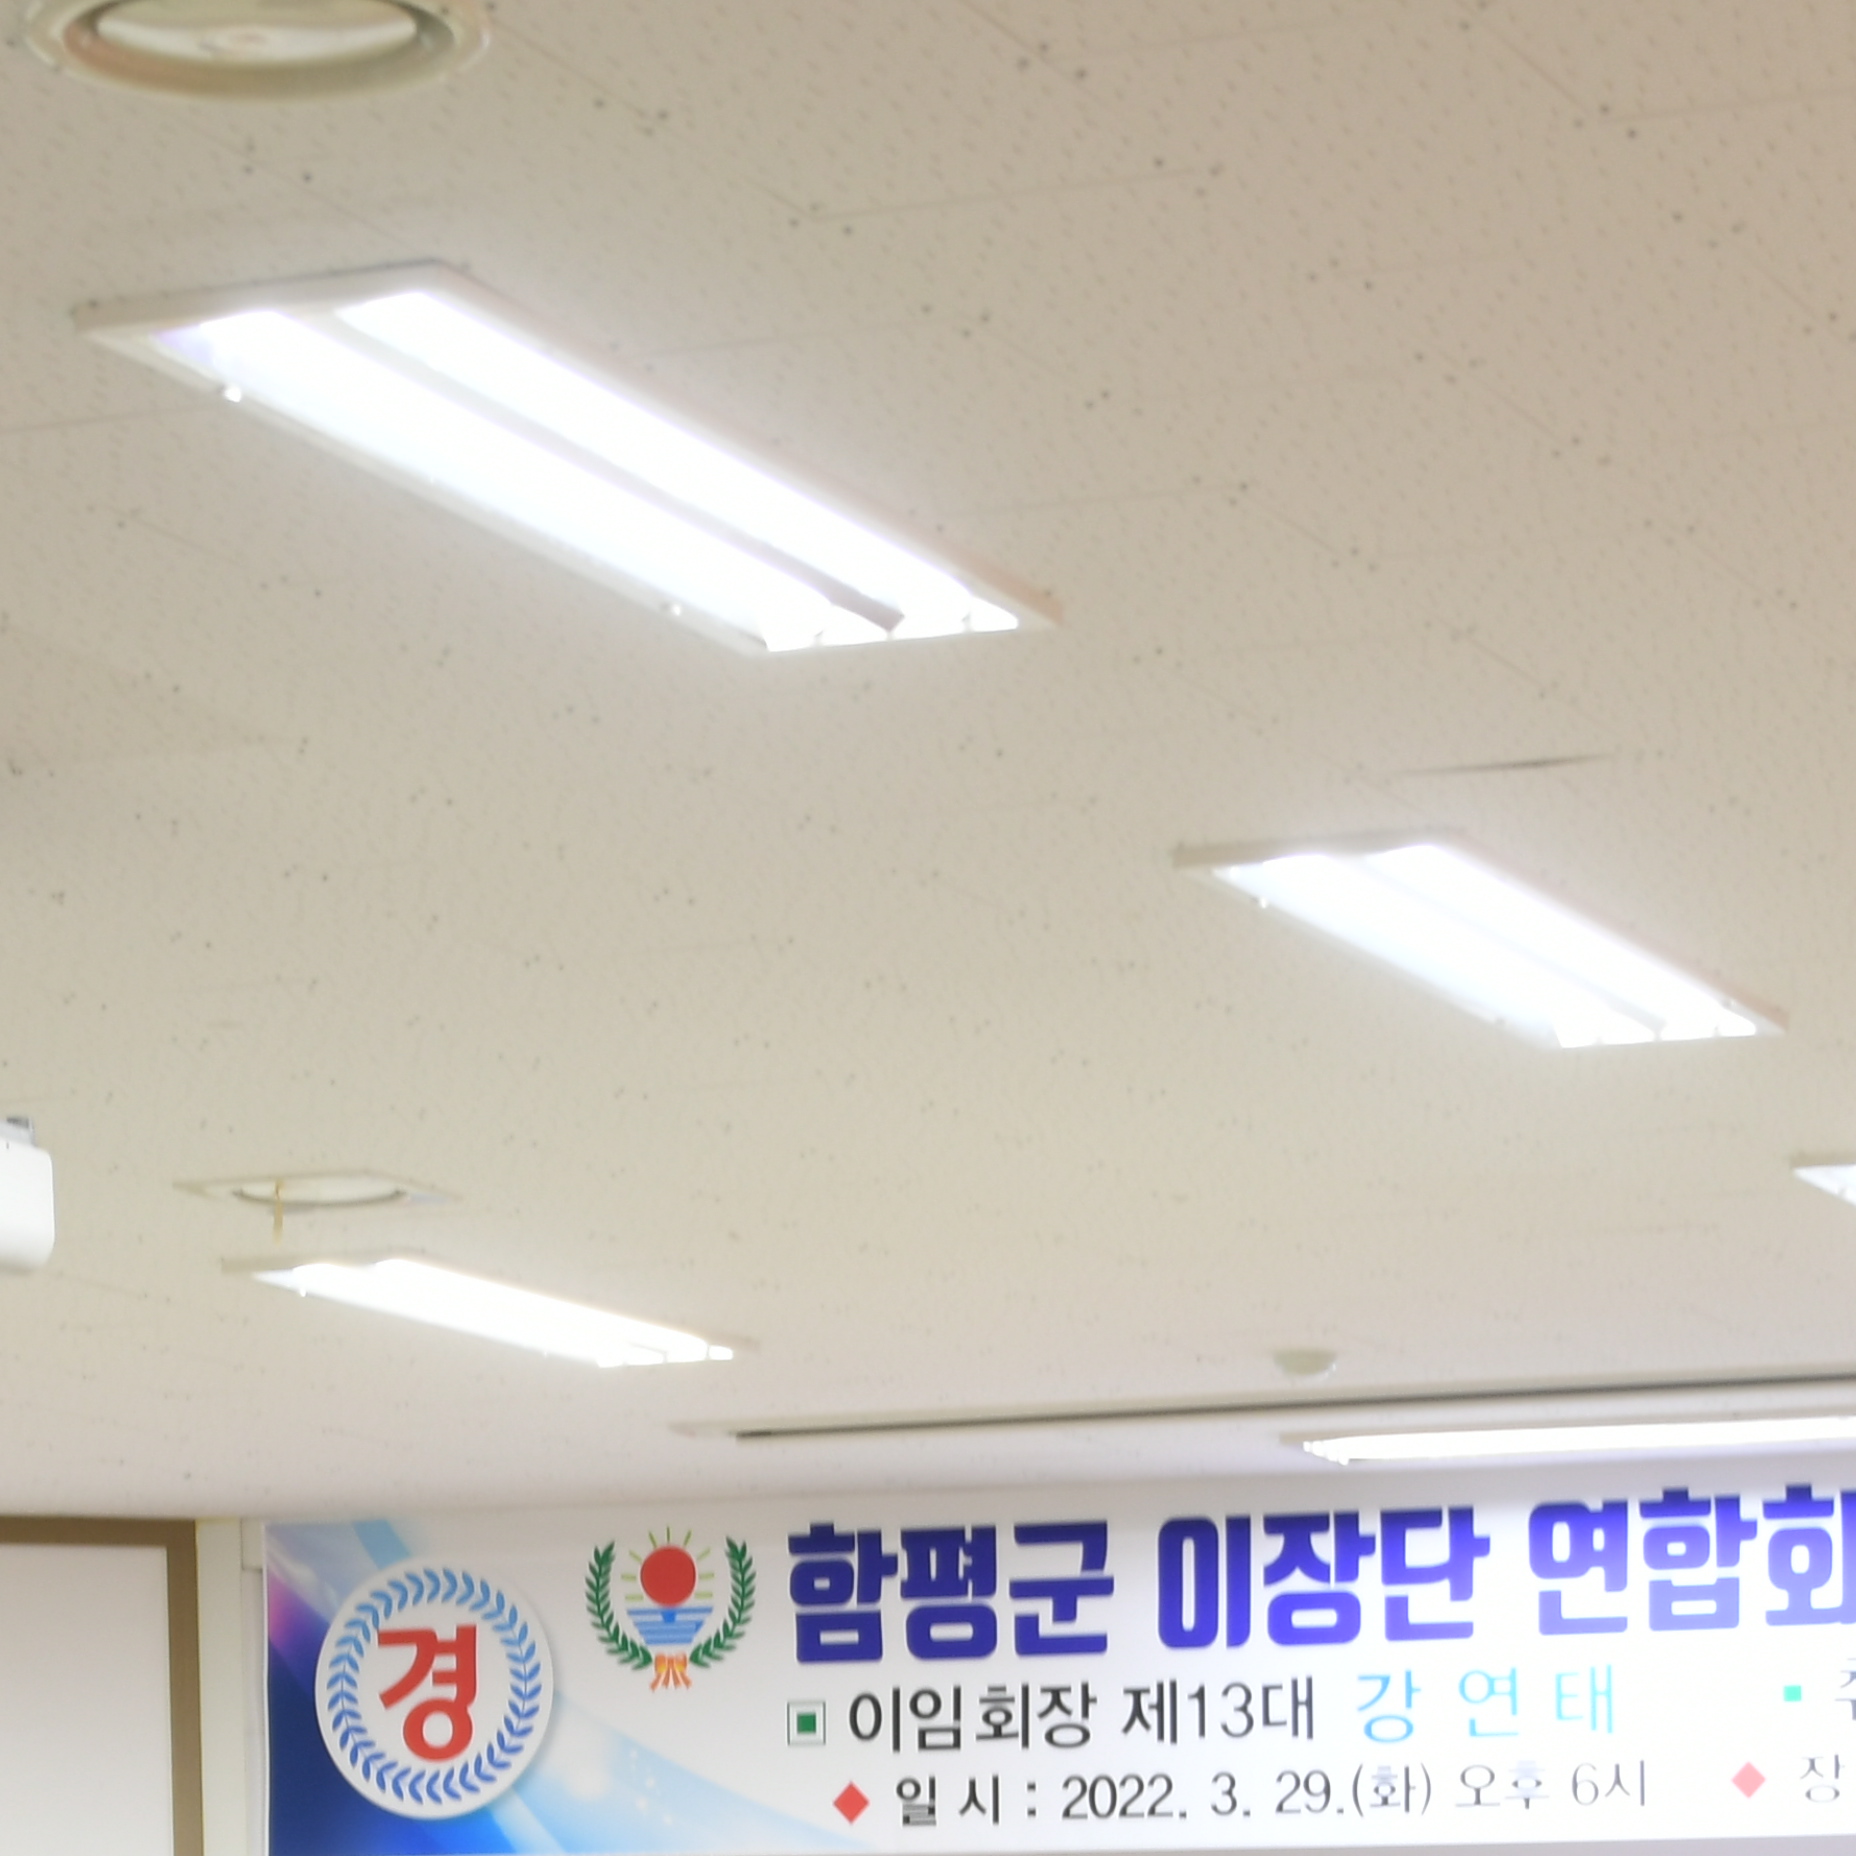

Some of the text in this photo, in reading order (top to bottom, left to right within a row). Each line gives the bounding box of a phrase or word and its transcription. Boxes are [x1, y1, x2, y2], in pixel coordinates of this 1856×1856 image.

[788, 1519, 1114, 1664] 함평군
[1156, 1504, 1490, 1649] 이장단
[377, 1624, 480, 1763] 경
[849, 1682, 1097, 1752] 이임회장
[1122, 1677, 1313, 1744] 제13대
[1062, 1774, 1186, 1819] 2022.
[1456, 1762, 1546, 1812] 오후
[1572, 1760, 1645, 1806] 6시
